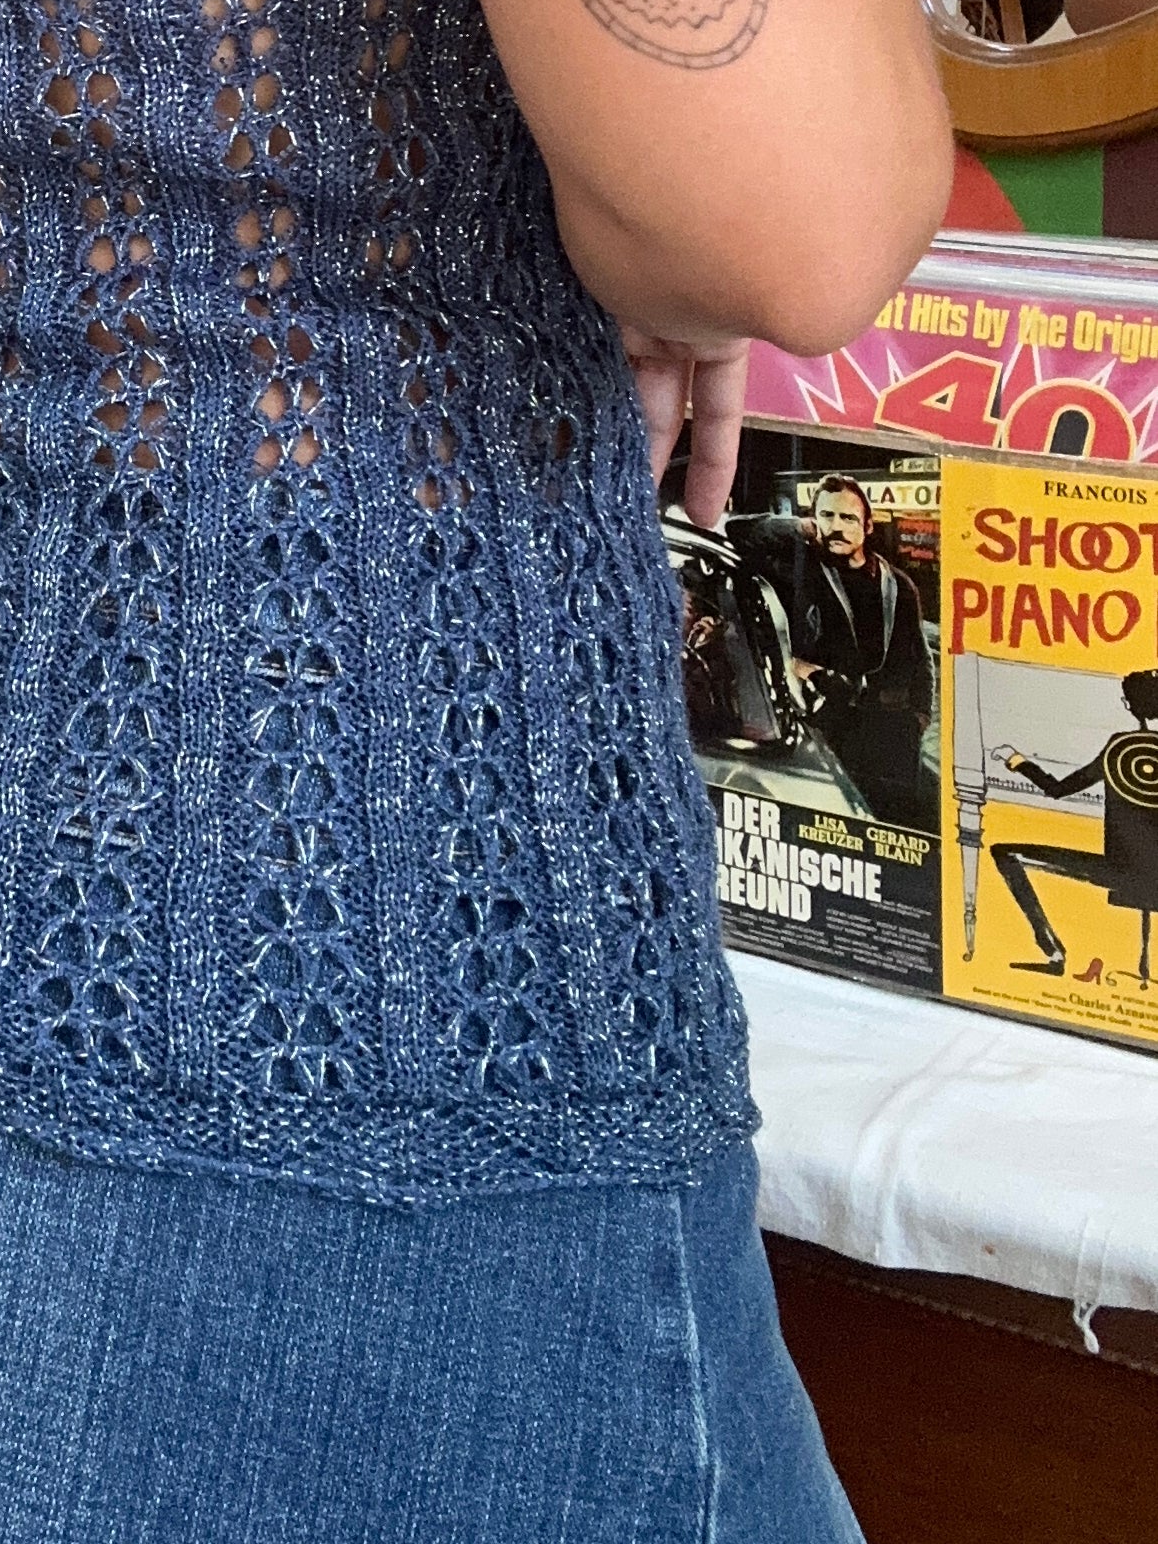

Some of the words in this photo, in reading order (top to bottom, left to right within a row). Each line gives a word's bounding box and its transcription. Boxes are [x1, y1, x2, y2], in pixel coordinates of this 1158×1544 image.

[909, 293, 969, 337] Hits
[973, 299, 1010, 348] by
[1018, 304, 1068, 348] the
[873, 350, 1137, 462] 40
[1044, 480, 1148, 505] FRANCOIS
[948, 577, 1142, 655] PIANO
[723, 791, 781, 841] DER
[814, 814, 848, 835] LISA
[798, 824, 864, 853] KREUZER
[865, 826, 931, 854] GERARD
[874, 841, 923, 867] BLAIN
